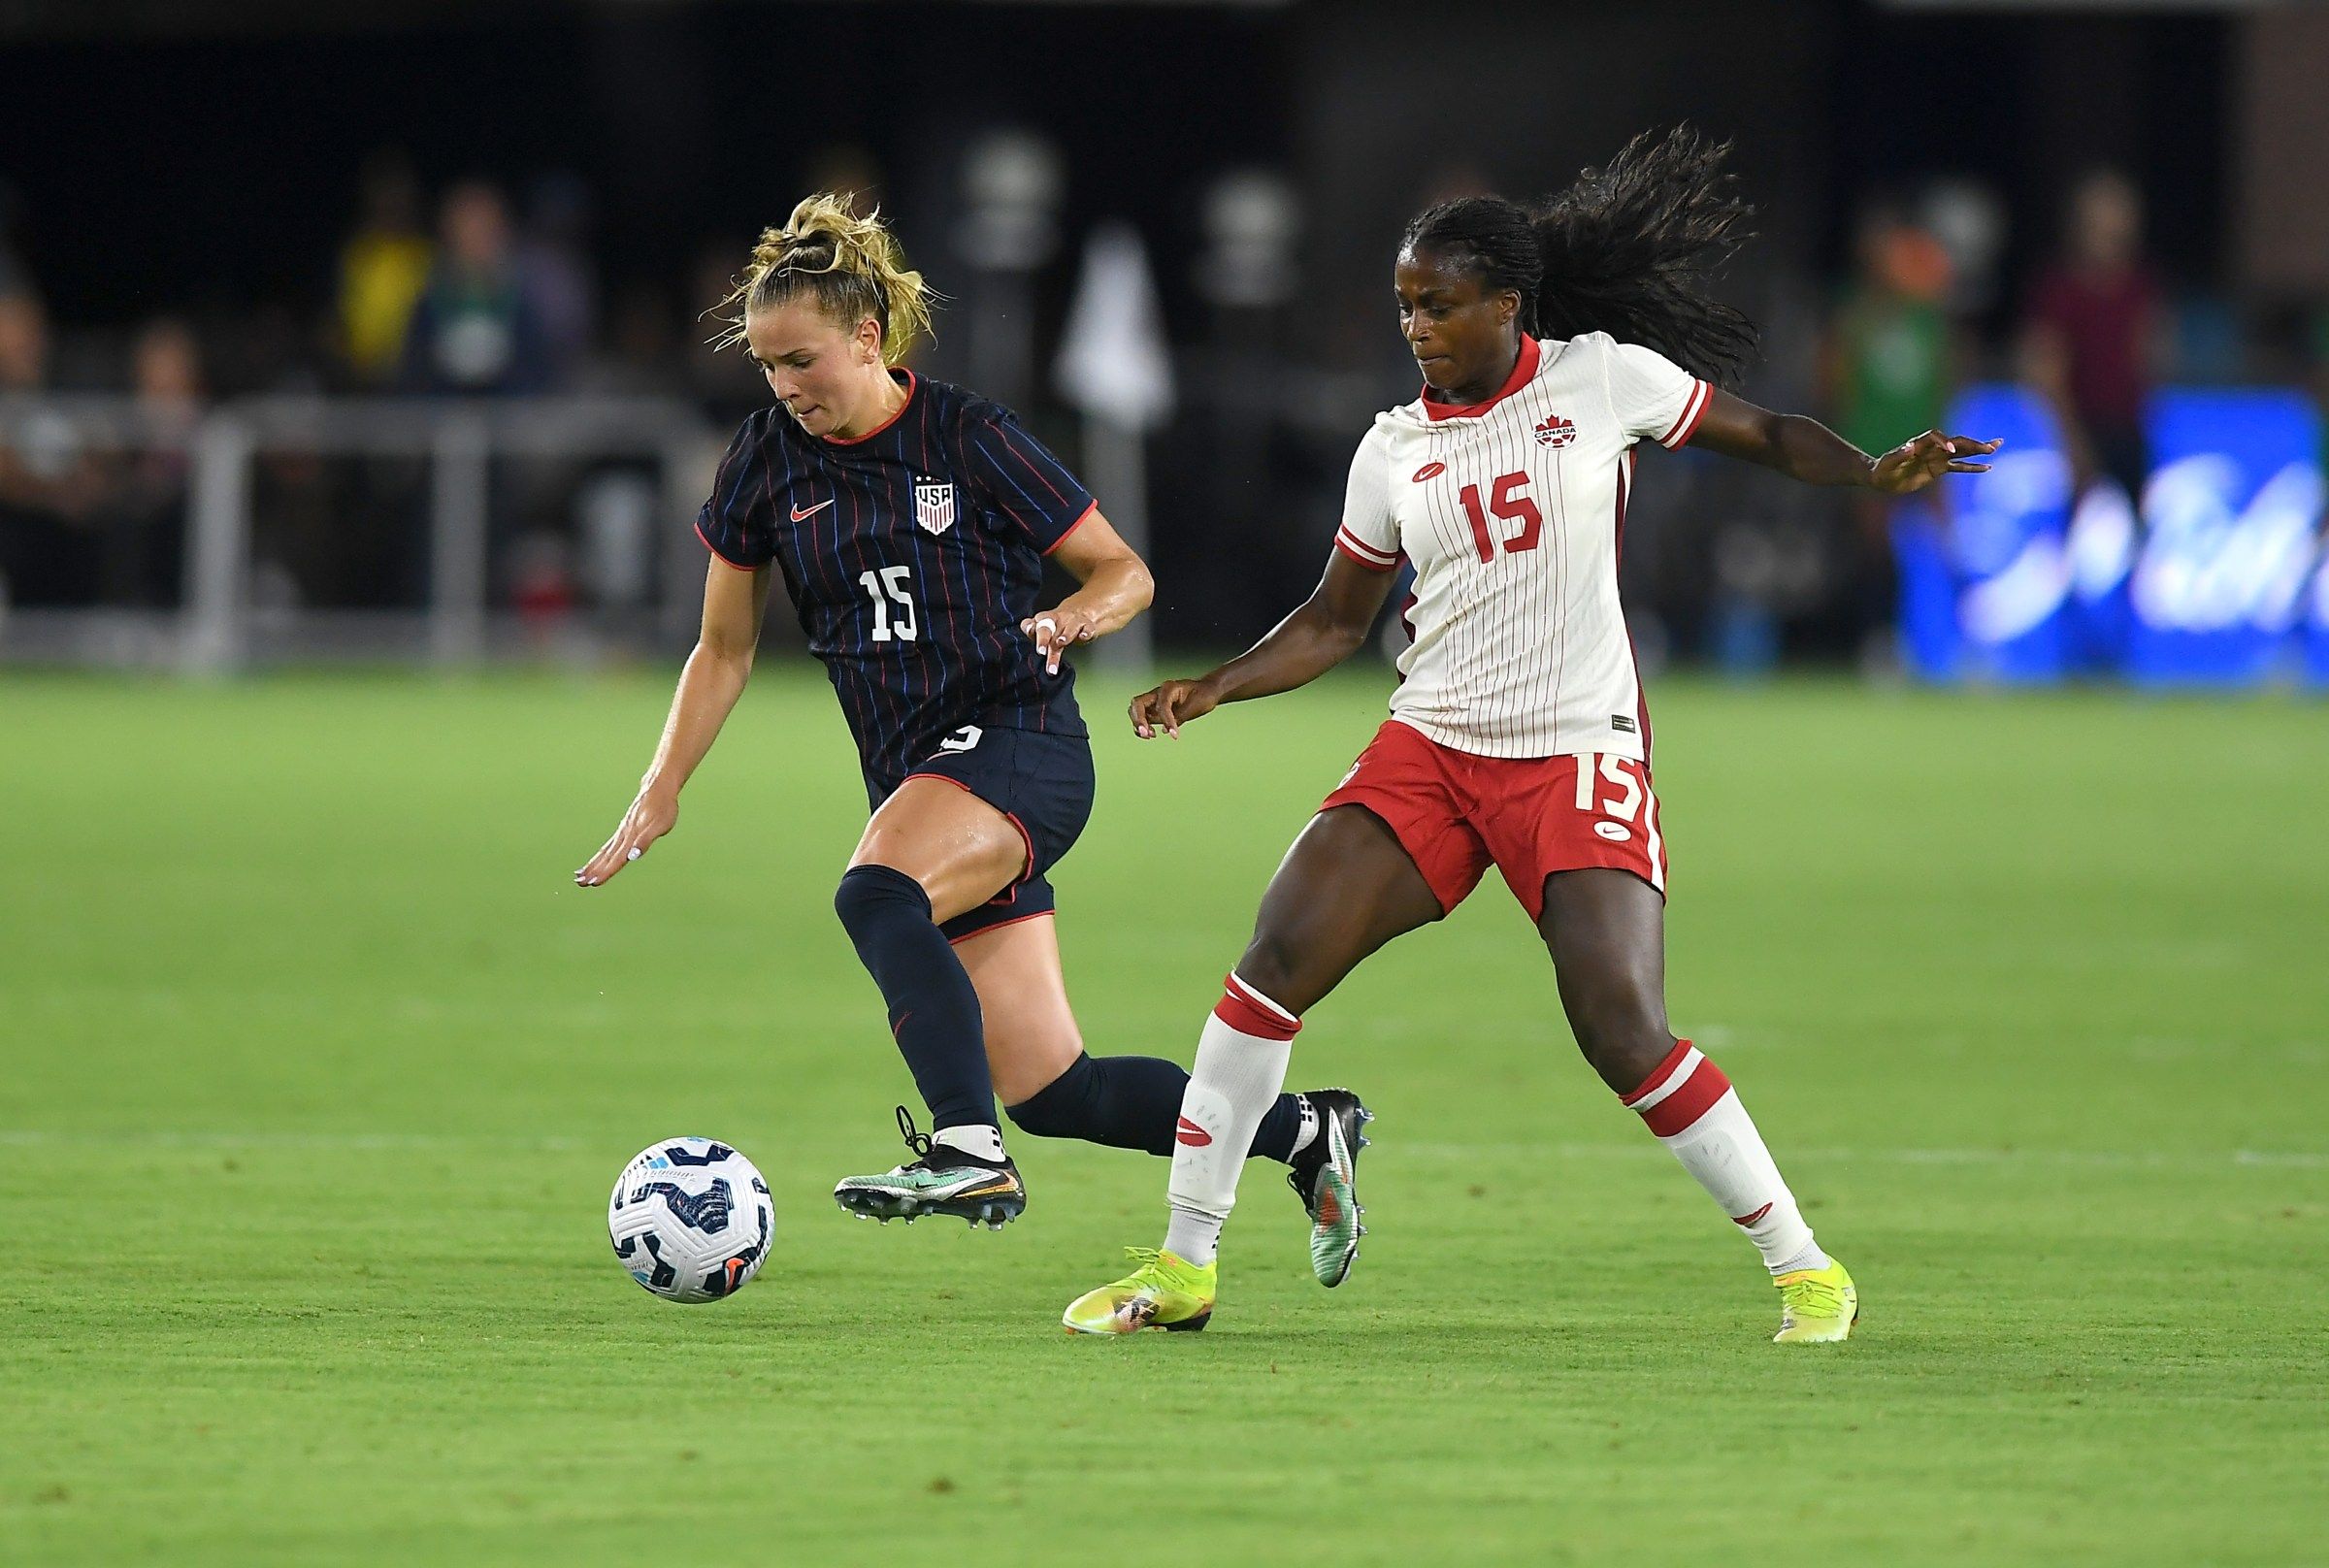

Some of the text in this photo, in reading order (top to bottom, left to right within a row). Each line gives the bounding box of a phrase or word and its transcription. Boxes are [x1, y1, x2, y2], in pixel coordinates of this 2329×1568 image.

[1534, 428, 1576, 438] CANADA
[918, 487, 950, 506] USA
[1460, 471, 1542, 564] 15
[859, 566, 917, 641] 15
[1572, 753, 1643, 823] 15
